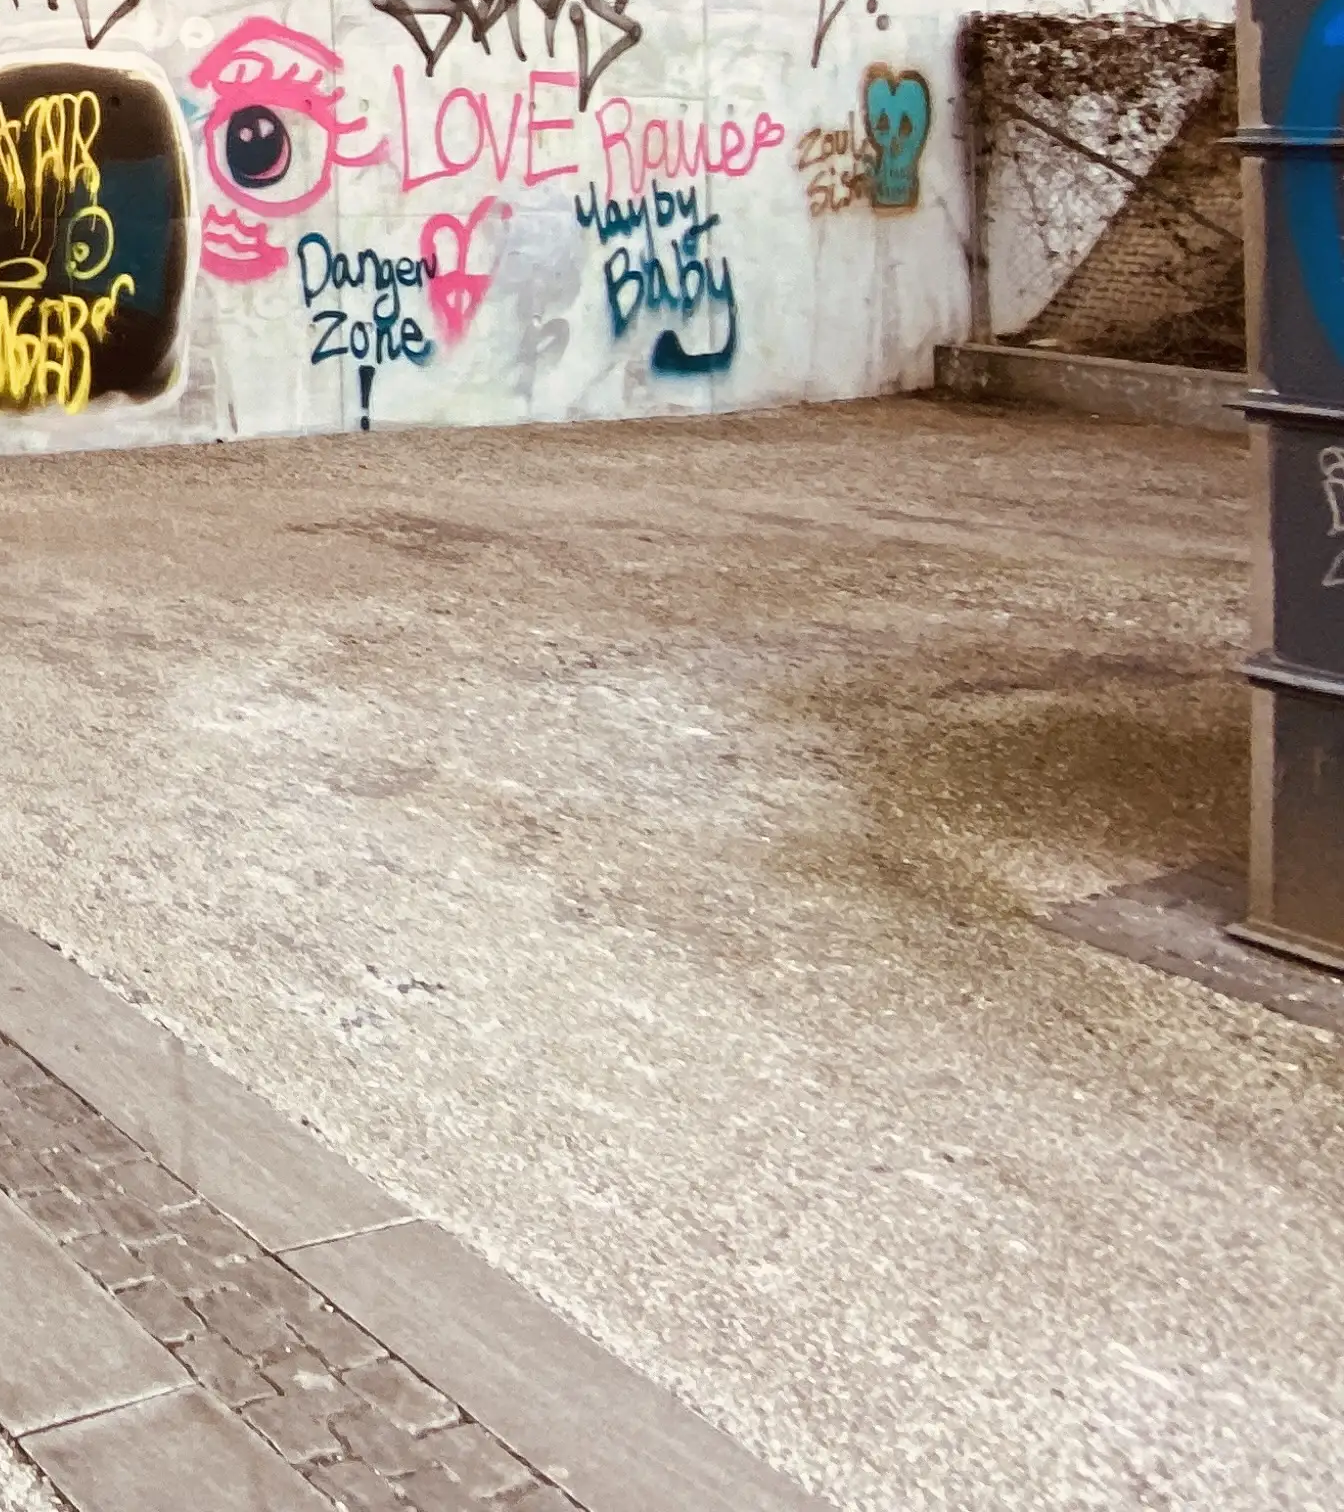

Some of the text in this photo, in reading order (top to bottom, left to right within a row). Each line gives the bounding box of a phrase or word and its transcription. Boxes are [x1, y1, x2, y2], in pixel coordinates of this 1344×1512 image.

[392, 64, 579, 193] LOVE
[297, 232, 437, 327] Danger
[604, 239, 739, 374] Baby
[310, 310, 436, 366] Zone
